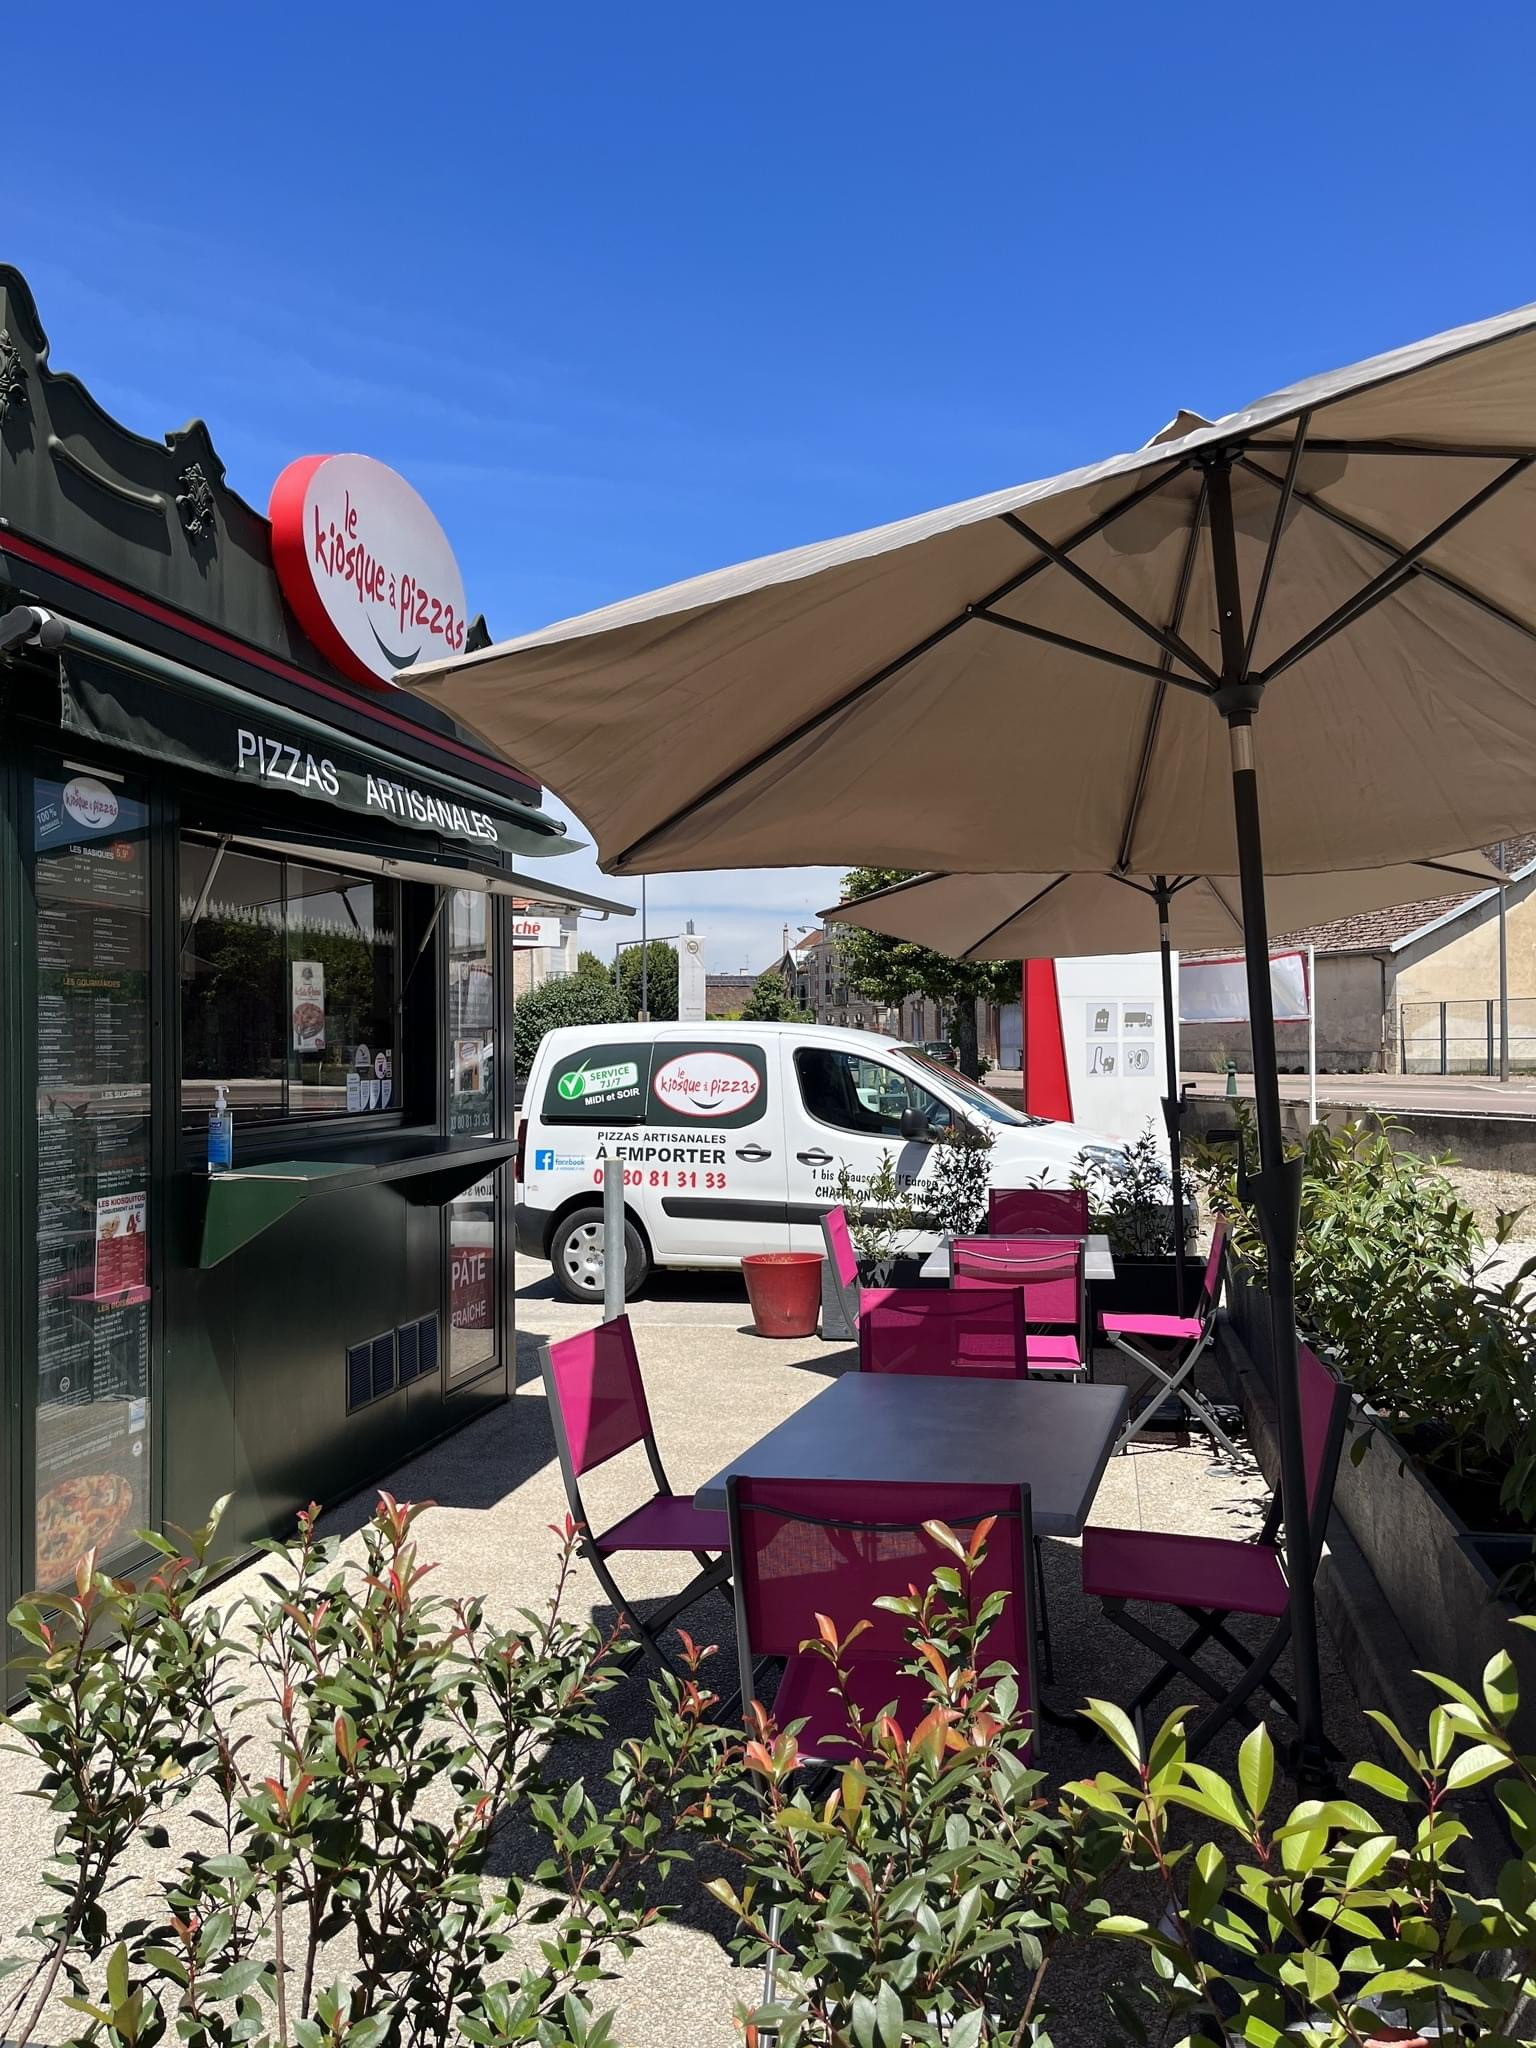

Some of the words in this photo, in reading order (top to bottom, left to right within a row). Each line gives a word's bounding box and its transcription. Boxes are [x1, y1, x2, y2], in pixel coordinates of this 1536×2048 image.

[344, 489, 358, 540] le
[314, 503, 386, 604] kiosque
[388, 572, 397, 610] à
[400, 573, 465, 651] pizzas
[237, 728, 340, 796] PIZZAS
[366, 773, 498, 842] ARTISANALES
[513, 920, 541, 935] ché
[590, 1066, 630, 1081] SERVICE
[677, 1067, 685, 1079] le
[600, 1077, 622, 1089] 7J/7
[660, 1075, 701, 1096] kiosque
[710, 1079, 756, 1097] pizzas
[584, 1093, 605, 1106] MIDI
[606, 1092, 616, 1101] et
[616, 1087, 640, 1100] SOIR
[597, 1131, 640, 1141] PIZZAS
[643, 1132, 727, 1144] ARTISANALES
[595, 1142, 608, 1160] À
[615, 1146, 727, 1164] EMPORTER
[649, 1170, 669, 1187] 81
[677, 1171, 697, 1188] 31
[705, 1172, 727, 1189] 33
[813, 1169, 817, 1180] 1
[821, 1169, 834, 1181] bis
[98, 1200, 110, 1208] LES
[111, 1194, 145, 1206] KIOSQUITOS
[900, 1192, 930, 1206] SEIN
[452, 1250, 486, 1291] PÂTE
[450, 1299, 486, 1329] FRAÎCHE
